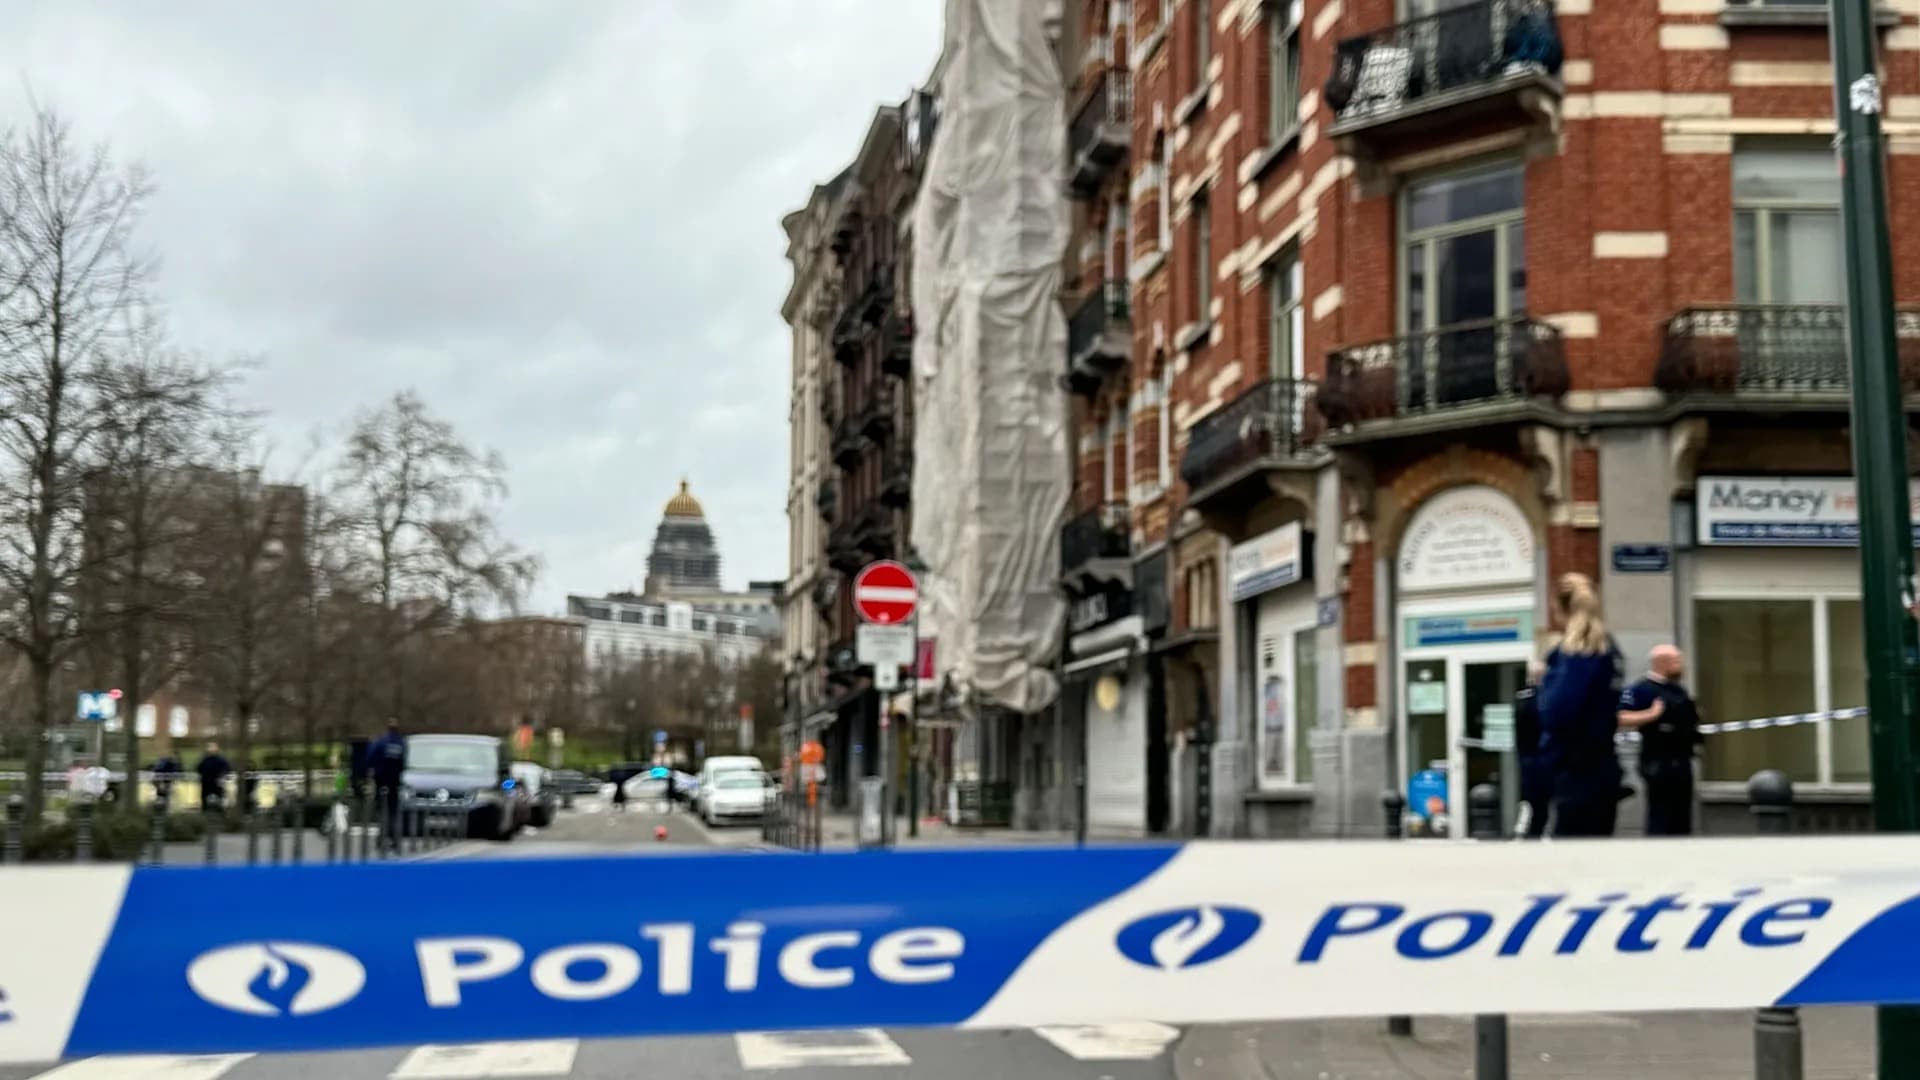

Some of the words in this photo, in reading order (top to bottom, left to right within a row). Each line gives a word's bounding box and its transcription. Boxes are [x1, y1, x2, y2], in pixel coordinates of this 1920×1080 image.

[1709, 482, 1827, 517] Money
[414, 921, 965, 1007] Police
[1297, 888, 1833, 964] Politie
